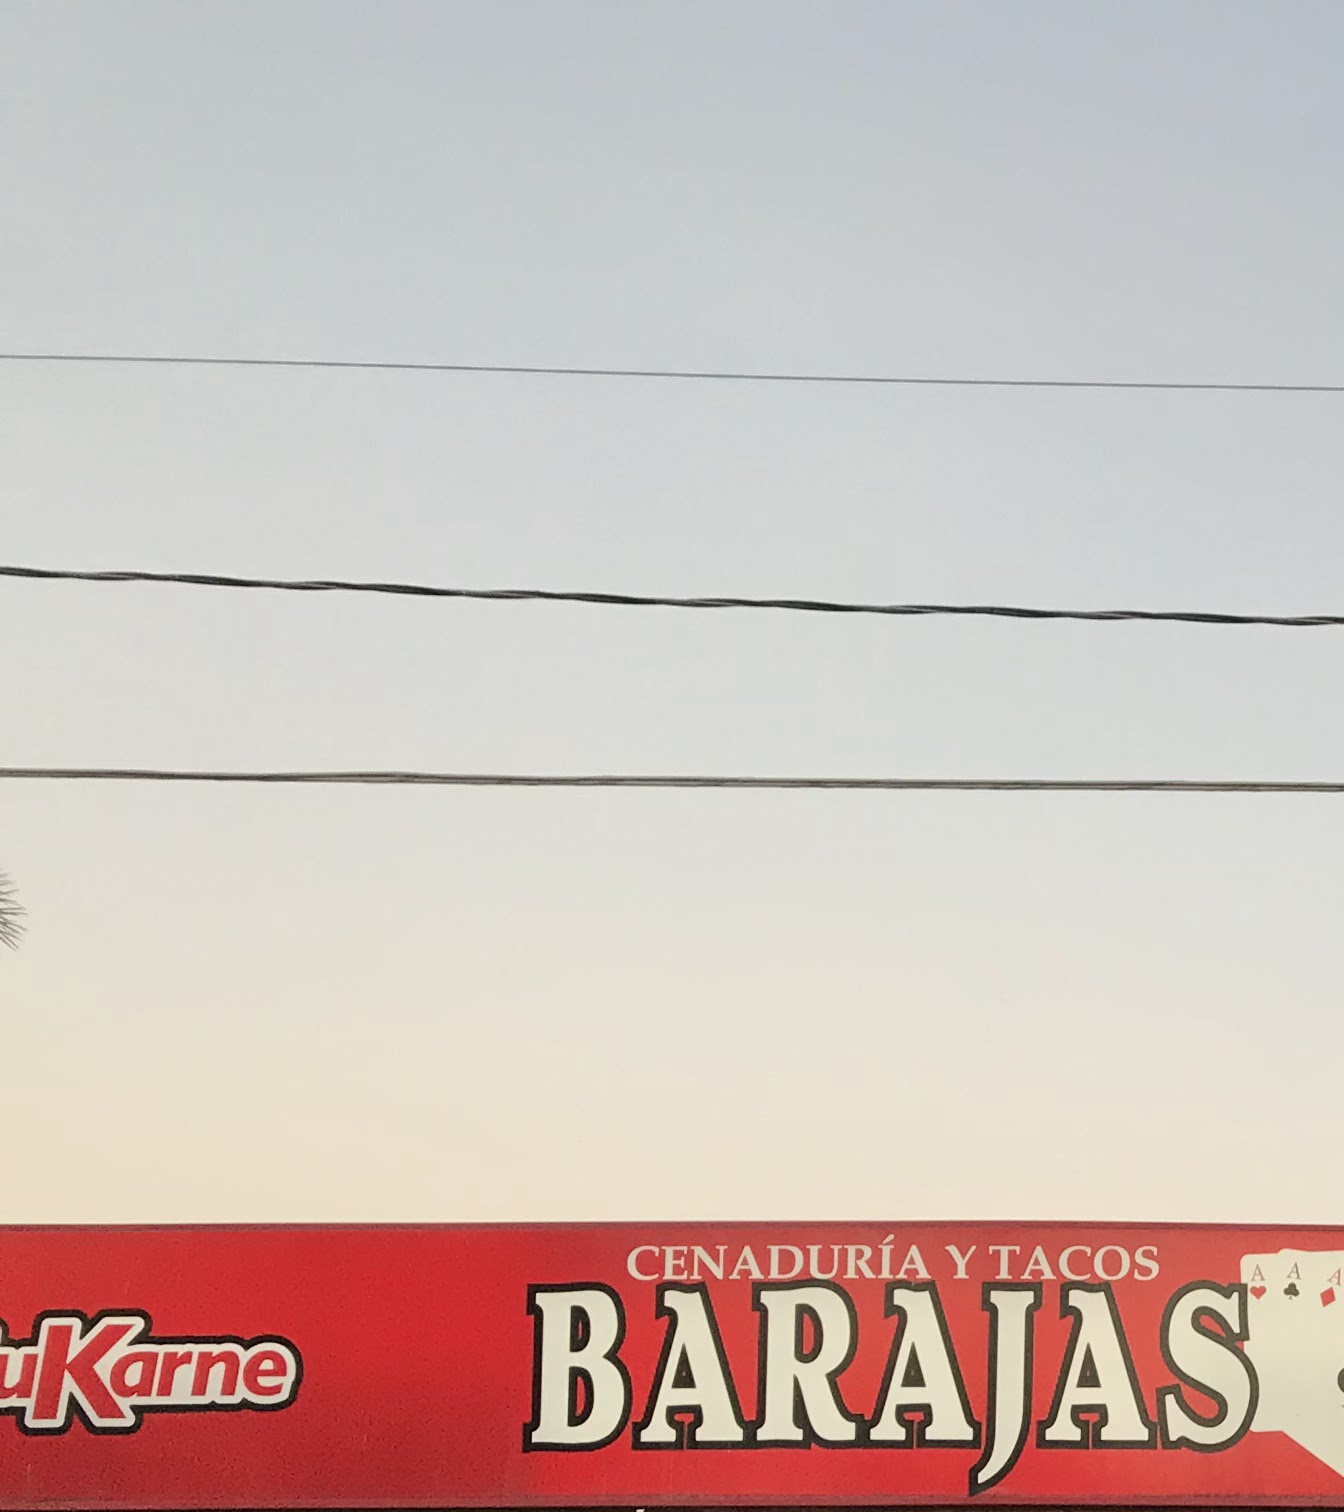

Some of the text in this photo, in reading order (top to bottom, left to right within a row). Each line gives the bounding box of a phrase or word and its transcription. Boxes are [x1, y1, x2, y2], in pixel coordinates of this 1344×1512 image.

[626, 1234, 1160, 1281] CENADURÍA Y TACOS
[1250, 1263, 1265, 1281] A
[1286, 1261, 1302, 1280] A
[1327, 1267, 1342, 1286] A
[0, 1315, 296, 1428] uKarne
[526, 1283, 1257, 1492] BARAJAS
